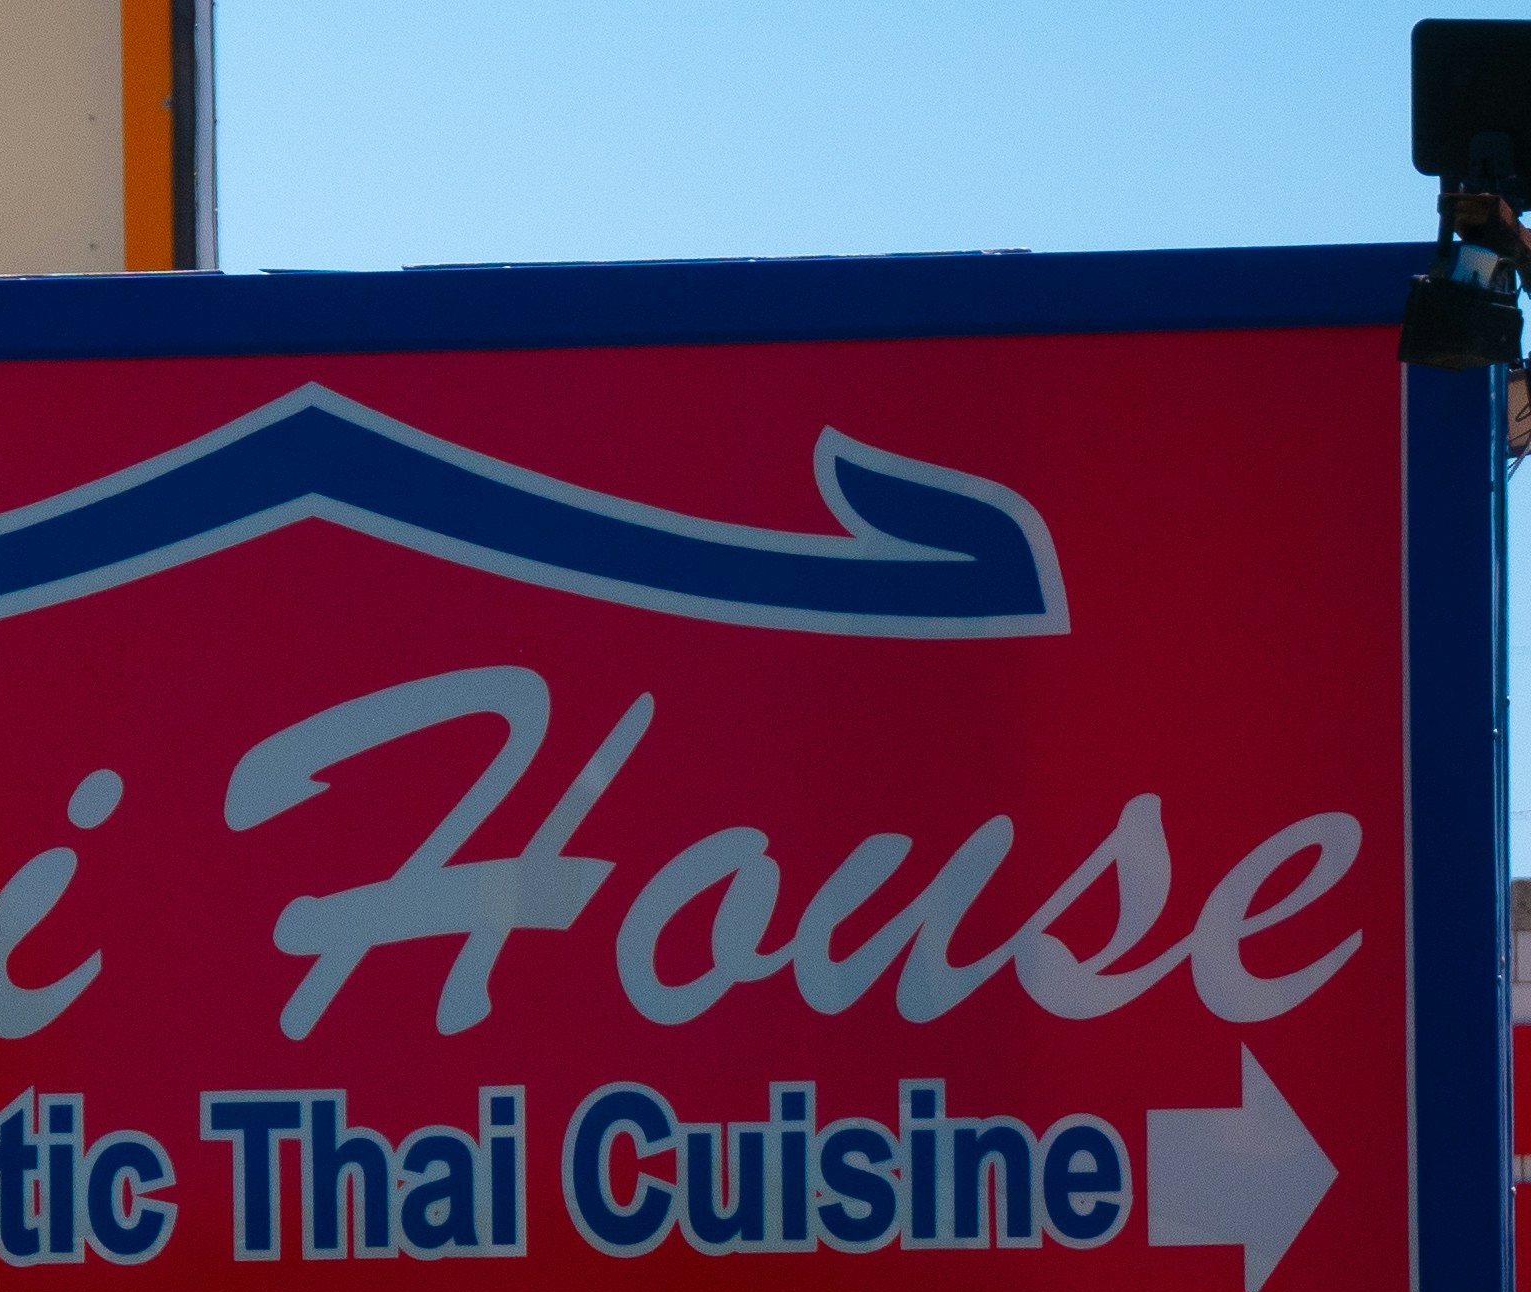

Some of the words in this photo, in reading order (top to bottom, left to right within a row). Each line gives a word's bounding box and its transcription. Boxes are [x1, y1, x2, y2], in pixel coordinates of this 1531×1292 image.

[223, 665, 1364, 1041] House
[199, 1085, 528, 1262] Thai
[561, 1078, 1133, 1259] Cuisine
